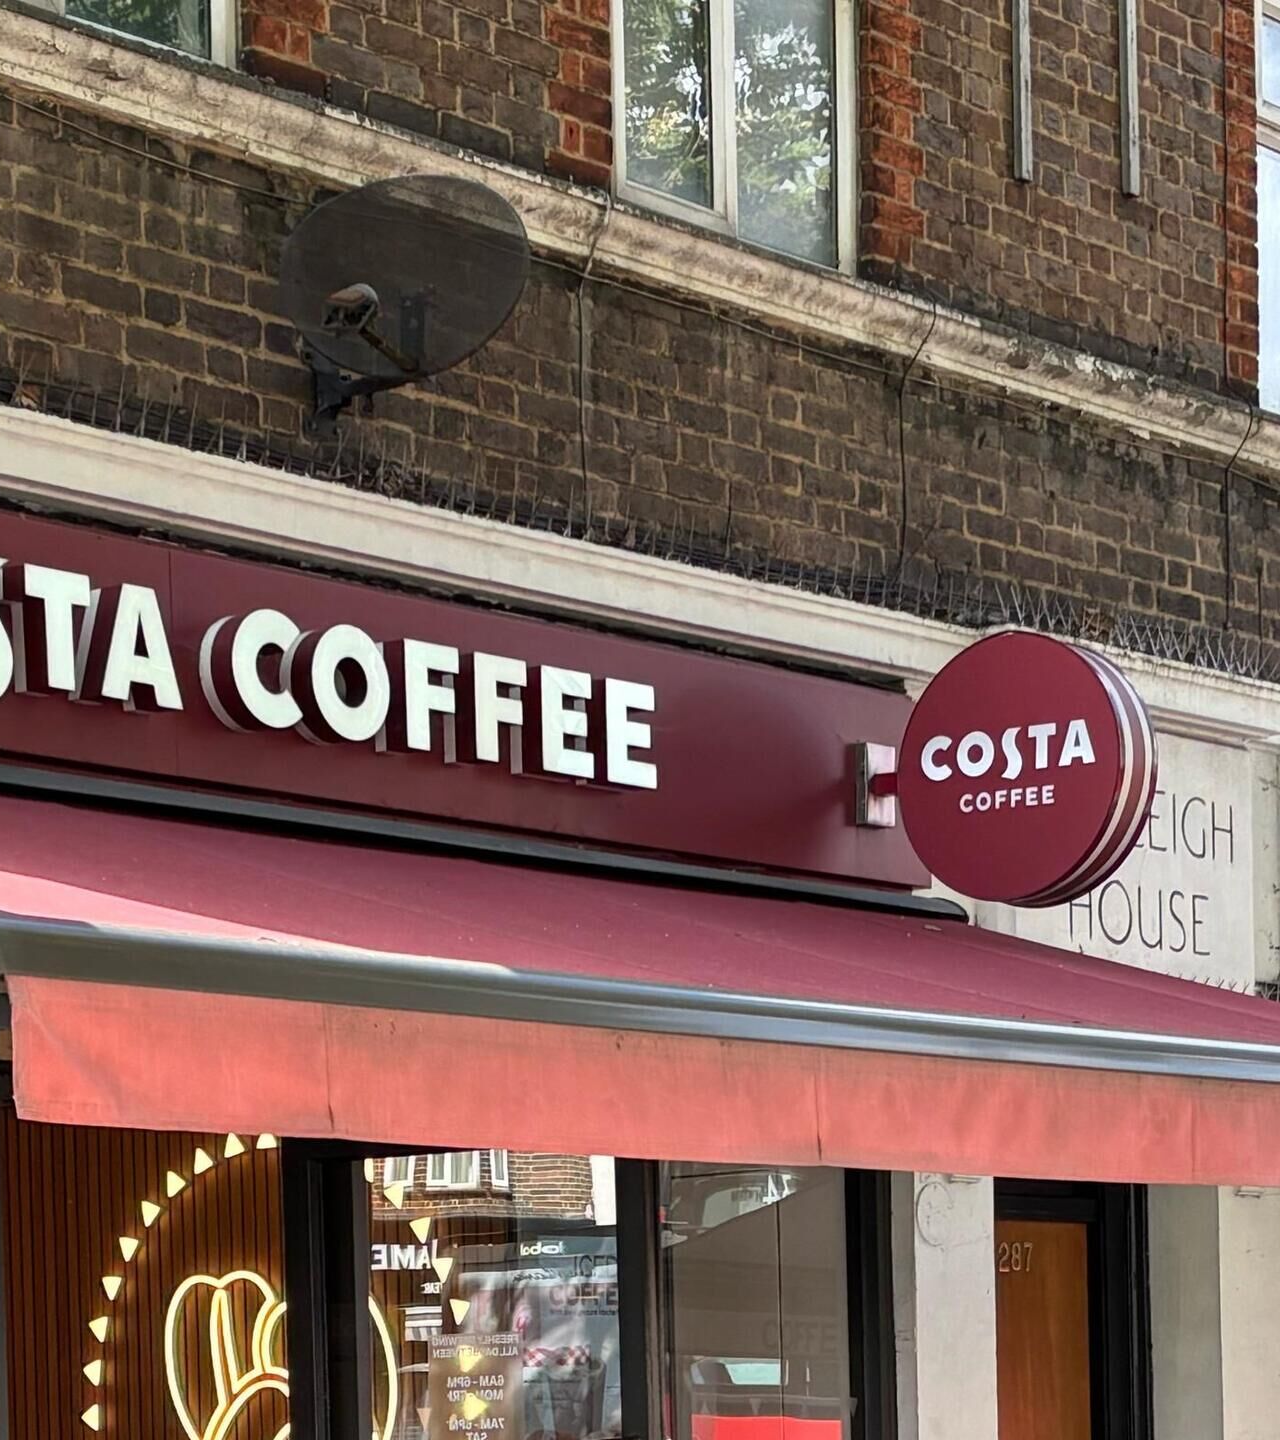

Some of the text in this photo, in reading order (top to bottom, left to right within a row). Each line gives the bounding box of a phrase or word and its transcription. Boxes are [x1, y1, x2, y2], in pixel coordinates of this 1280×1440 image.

[200, 609, 658, 790] COFFEE
[920, 719, 1096, 782] COSTA
[959, 784, 1055, 814] COFFEE
[1132, 790, 1234, 864] EIGH
[1069, 879, 1211, 956] HOUSE
[999, 1242, 1033, 1272] 287
